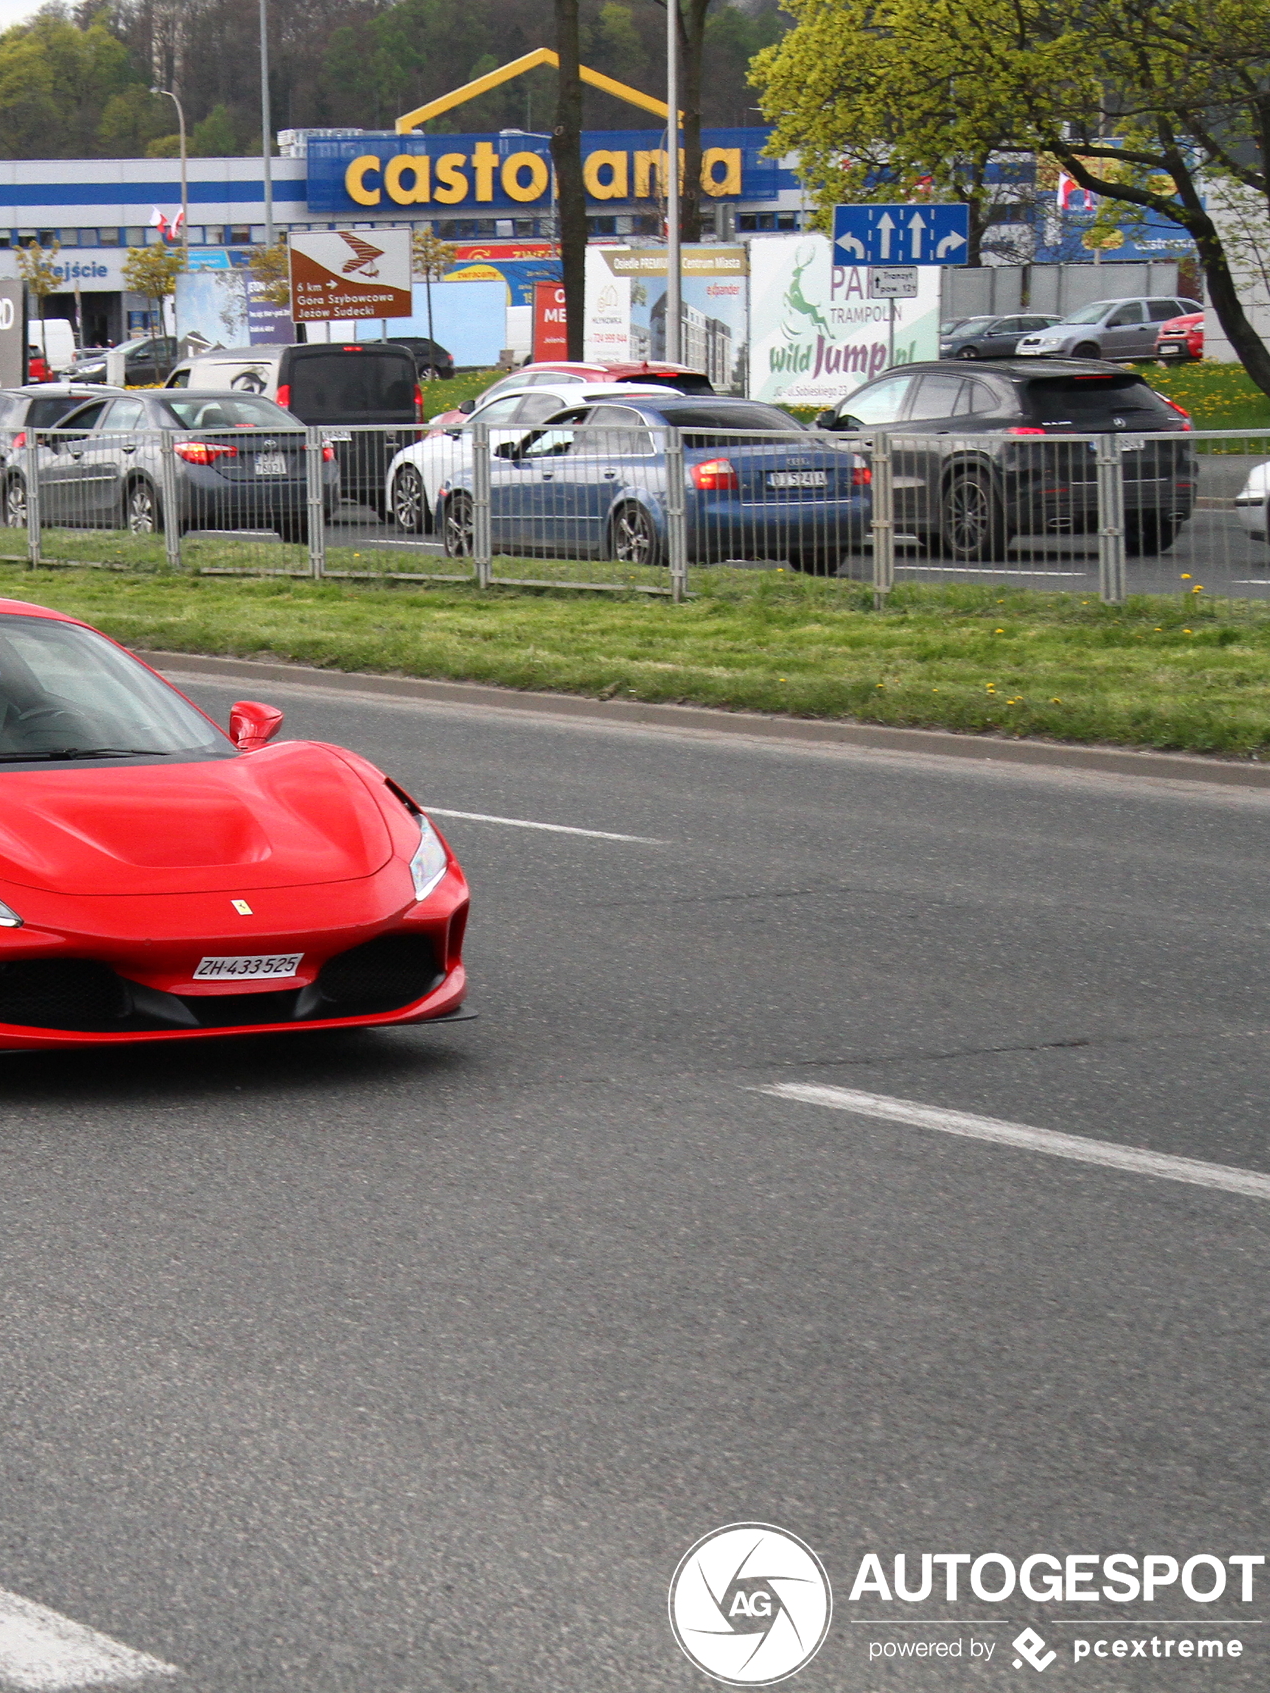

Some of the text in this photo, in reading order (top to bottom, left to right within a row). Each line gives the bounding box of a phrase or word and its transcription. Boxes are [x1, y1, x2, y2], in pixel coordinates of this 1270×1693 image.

[344, 141, 742, 206] castoama
[640, 257, 669, 269] PREMIU
[41, 261, 108, 281] ejście
[296, 282, 304, 292] 6
[306, 282, 323, 292] km
[297, 293, 394, 306] Góra Szybowcowa
[333, 305, 375, 317] Sudecki
[830, 306, 902, 324] TRAMPOLN
